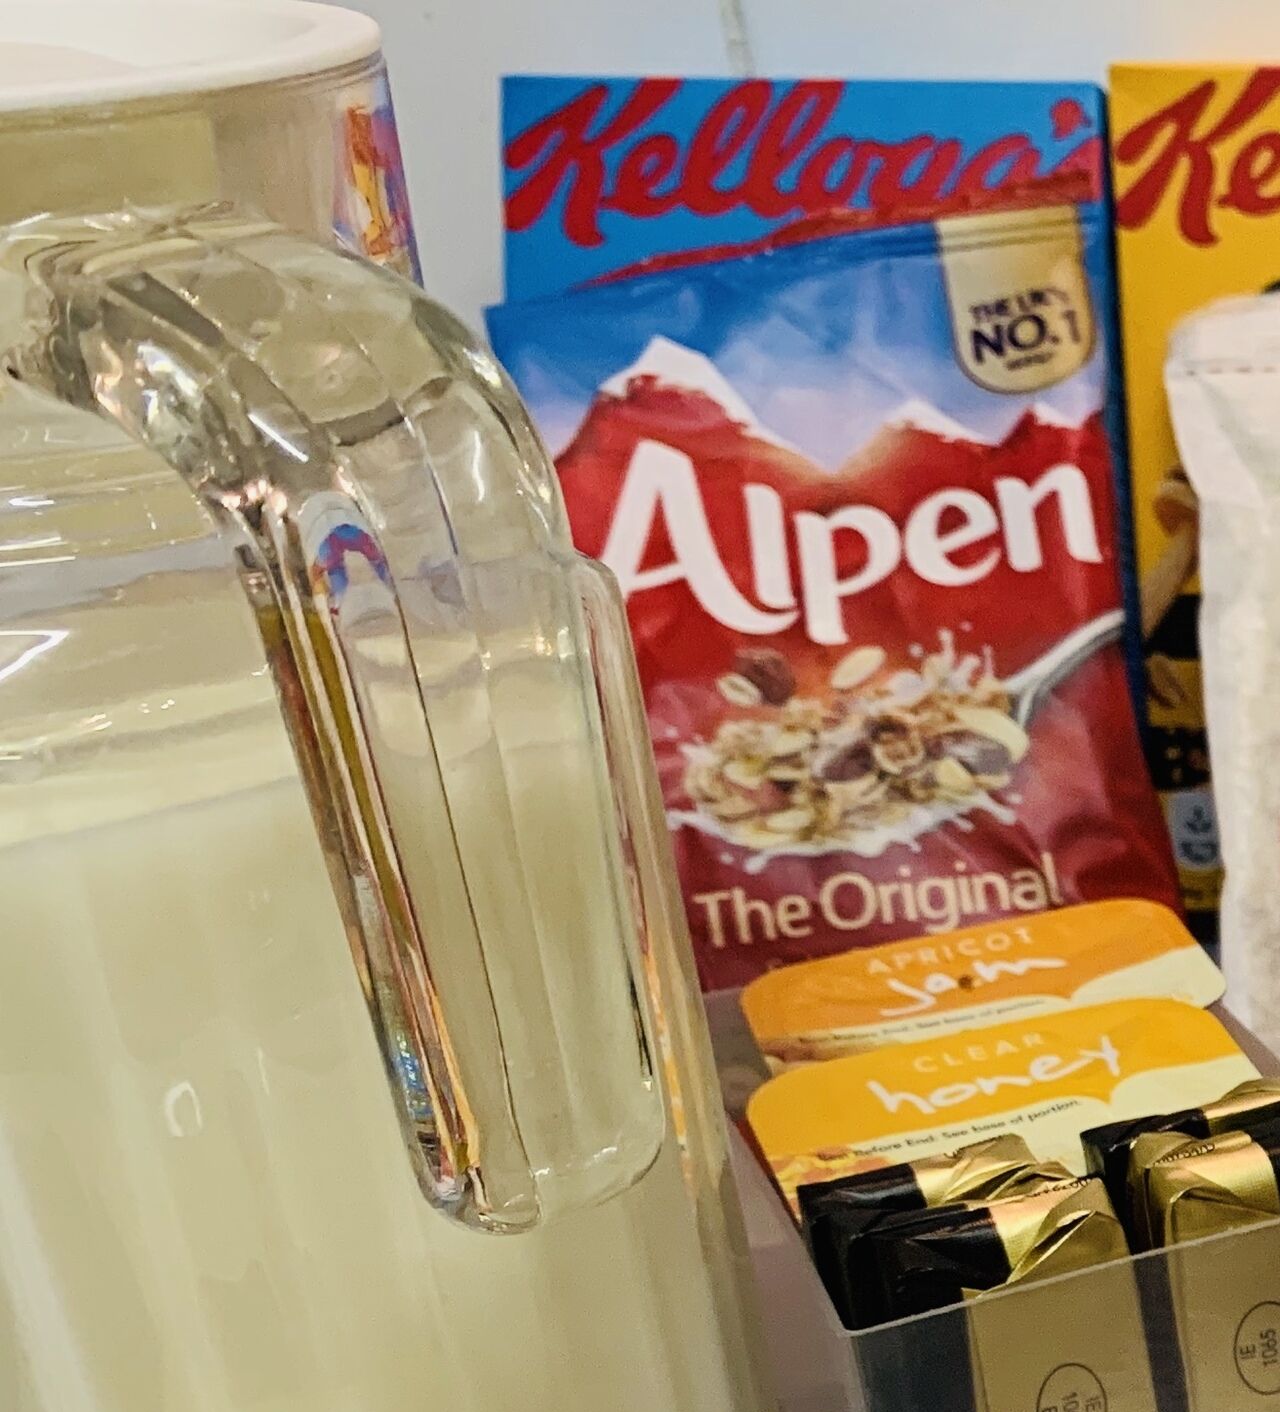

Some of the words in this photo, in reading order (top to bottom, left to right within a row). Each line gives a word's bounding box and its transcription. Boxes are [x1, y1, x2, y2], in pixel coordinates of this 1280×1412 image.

[601, 439, 1103, 646] Alpen
[694, 890, 811, 948] The
[819, 852, 1066, 936] Original
[868, 927, 1031, 975] APRICOT
[866, 1035, 1121, 1115] honey
[912, 1032, 1044, 1073] CLEAR
